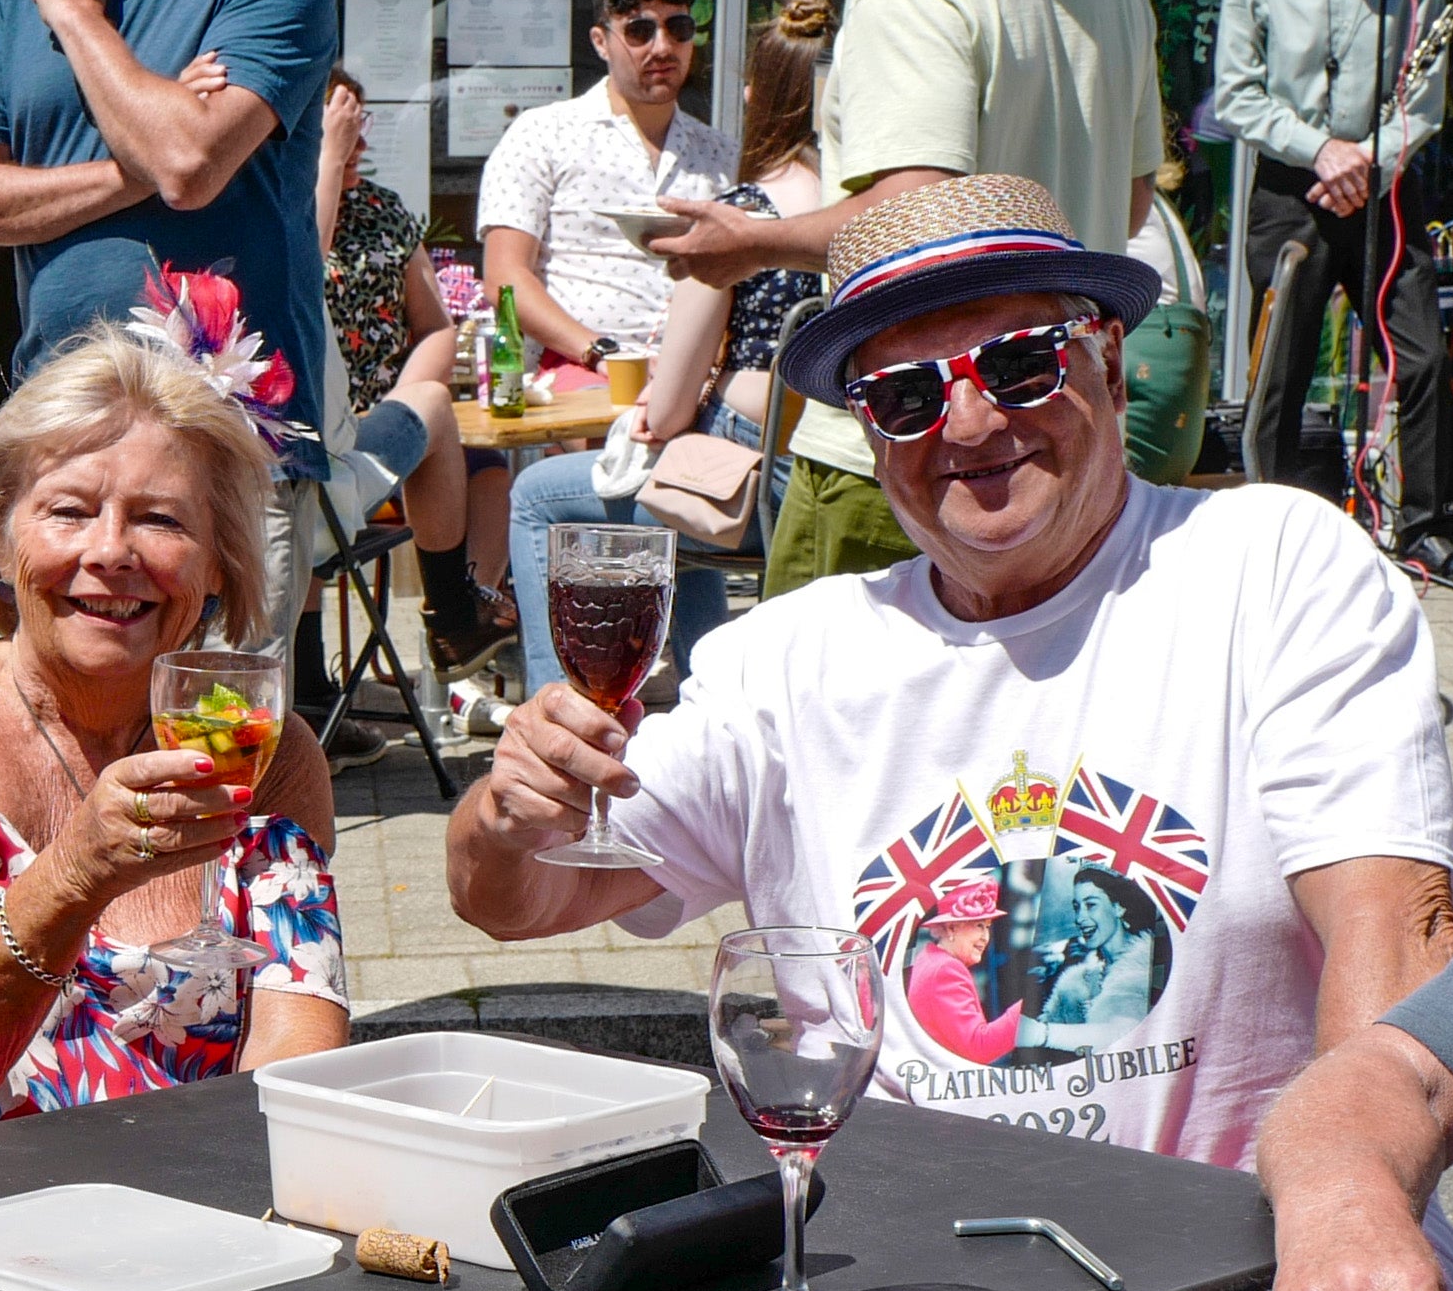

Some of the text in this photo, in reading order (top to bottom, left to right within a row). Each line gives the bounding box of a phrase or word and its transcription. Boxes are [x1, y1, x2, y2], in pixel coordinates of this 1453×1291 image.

[896, 1037, 1197, 1105] PLATINUM JUBILEE
[987, 1103, 1110, 1145] 22
